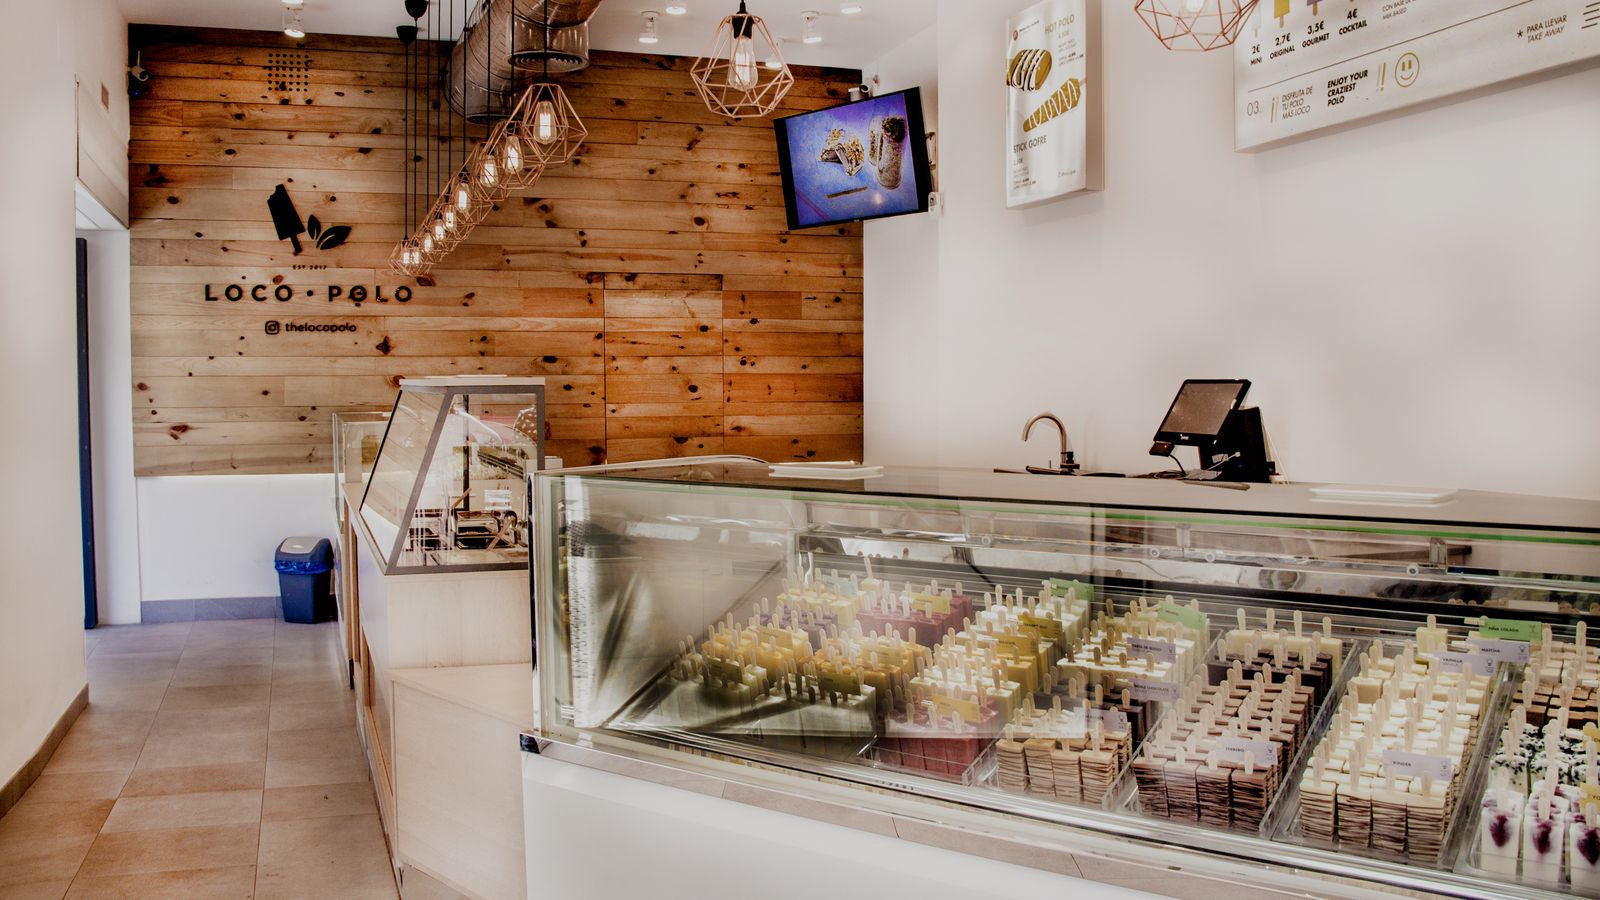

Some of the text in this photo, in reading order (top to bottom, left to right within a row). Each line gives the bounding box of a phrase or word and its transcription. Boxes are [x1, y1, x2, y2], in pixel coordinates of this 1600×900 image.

[1347, 9, 1358, 20] 4€
[1044, 22, 1057, 33] HOT
[1058, 14, 1075, 27] POLO
[1307, 21, 1324, 35] 3,5€
[1339, 20, 1367, 35] COCKTAIL
[1526, 15, 1567, 33] PARA LLEVAR
[1275, 33, 1291, 46] 2,7€
[1302, 33, 1330, 48] GOURMET
[1527, 24, 1566, 43] TAKE AWAY
[1252, 44, 1260, 54] 2€
[1270, 46, 1295, 59] ORIGINAL
[1250, 56, 1263, 66] MINI
[1327, 69, 1369, 89] ENJOY YOUR
[1282, 87, 1313, 103] DISFRUTA DE
[1327, 82, 1356, 98] CRAZIEST
[1282, 98, 1304, 111] TU POLO
[1327, 95, 1345, 107] POLO
[1295, 105, 1311, 116] LOCO
[1013, 135, 1047, 153] STICK GOFRE
[204, 284, 412, 302] LOCO POLO
[285, 322, 357, 333] thelocopolo
